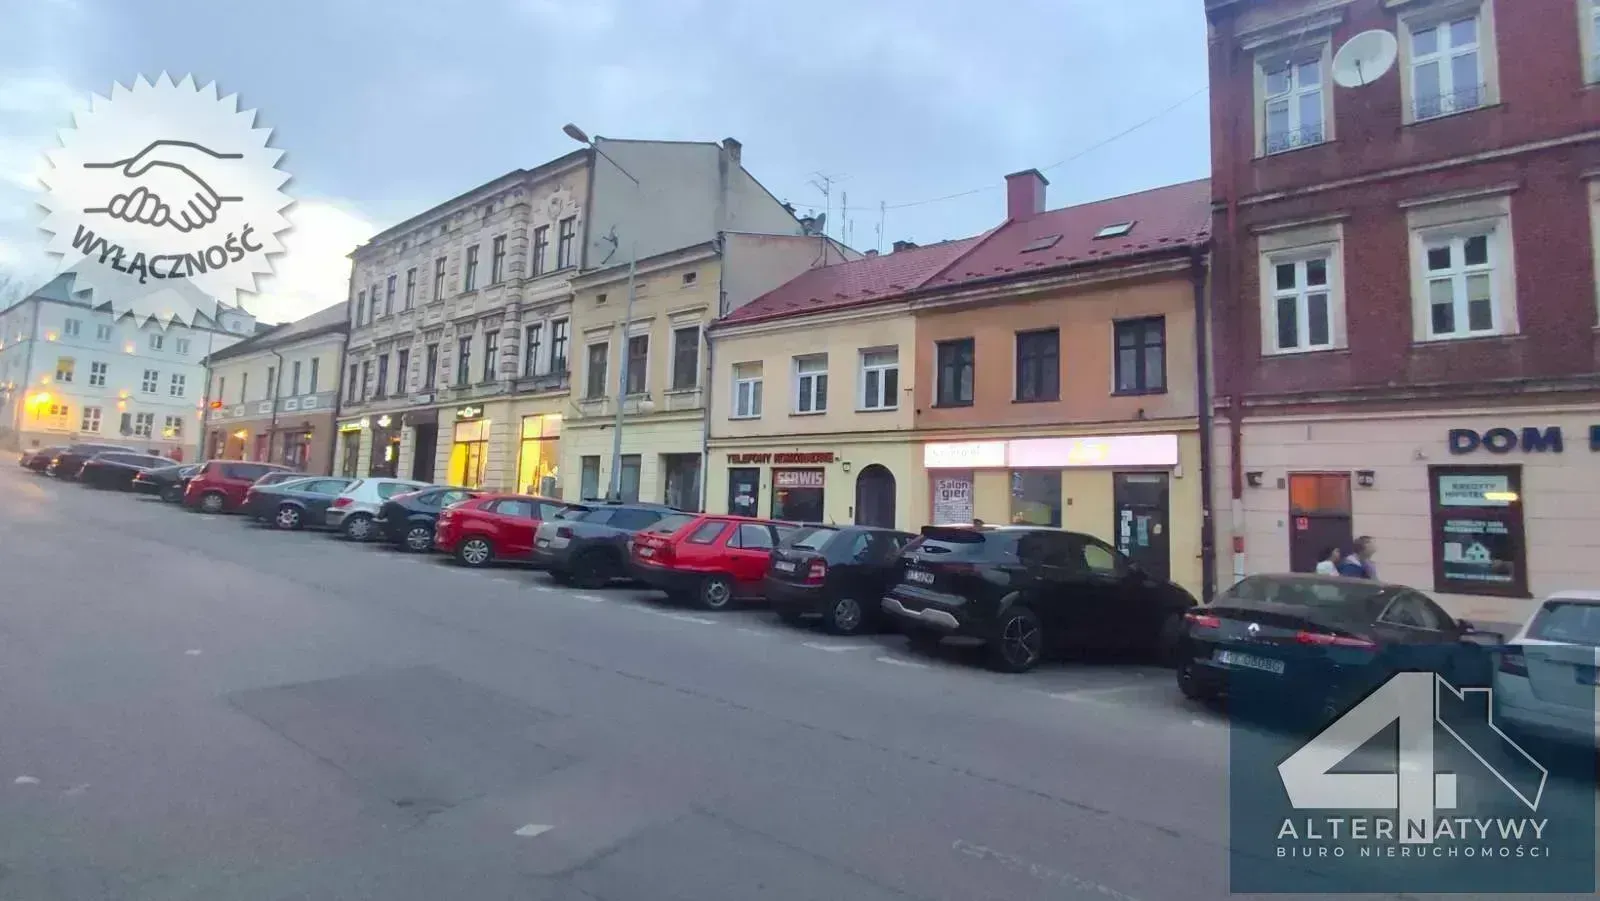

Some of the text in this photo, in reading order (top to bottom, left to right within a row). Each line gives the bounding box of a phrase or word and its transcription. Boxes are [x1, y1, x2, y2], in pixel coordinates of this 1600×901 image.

[1448, 426, 1563, 454] DOM
[777, 472, 823, 485] SERWIS
[939, 480, 968, 489] Salon
[942, 489, 966, 501] gier
